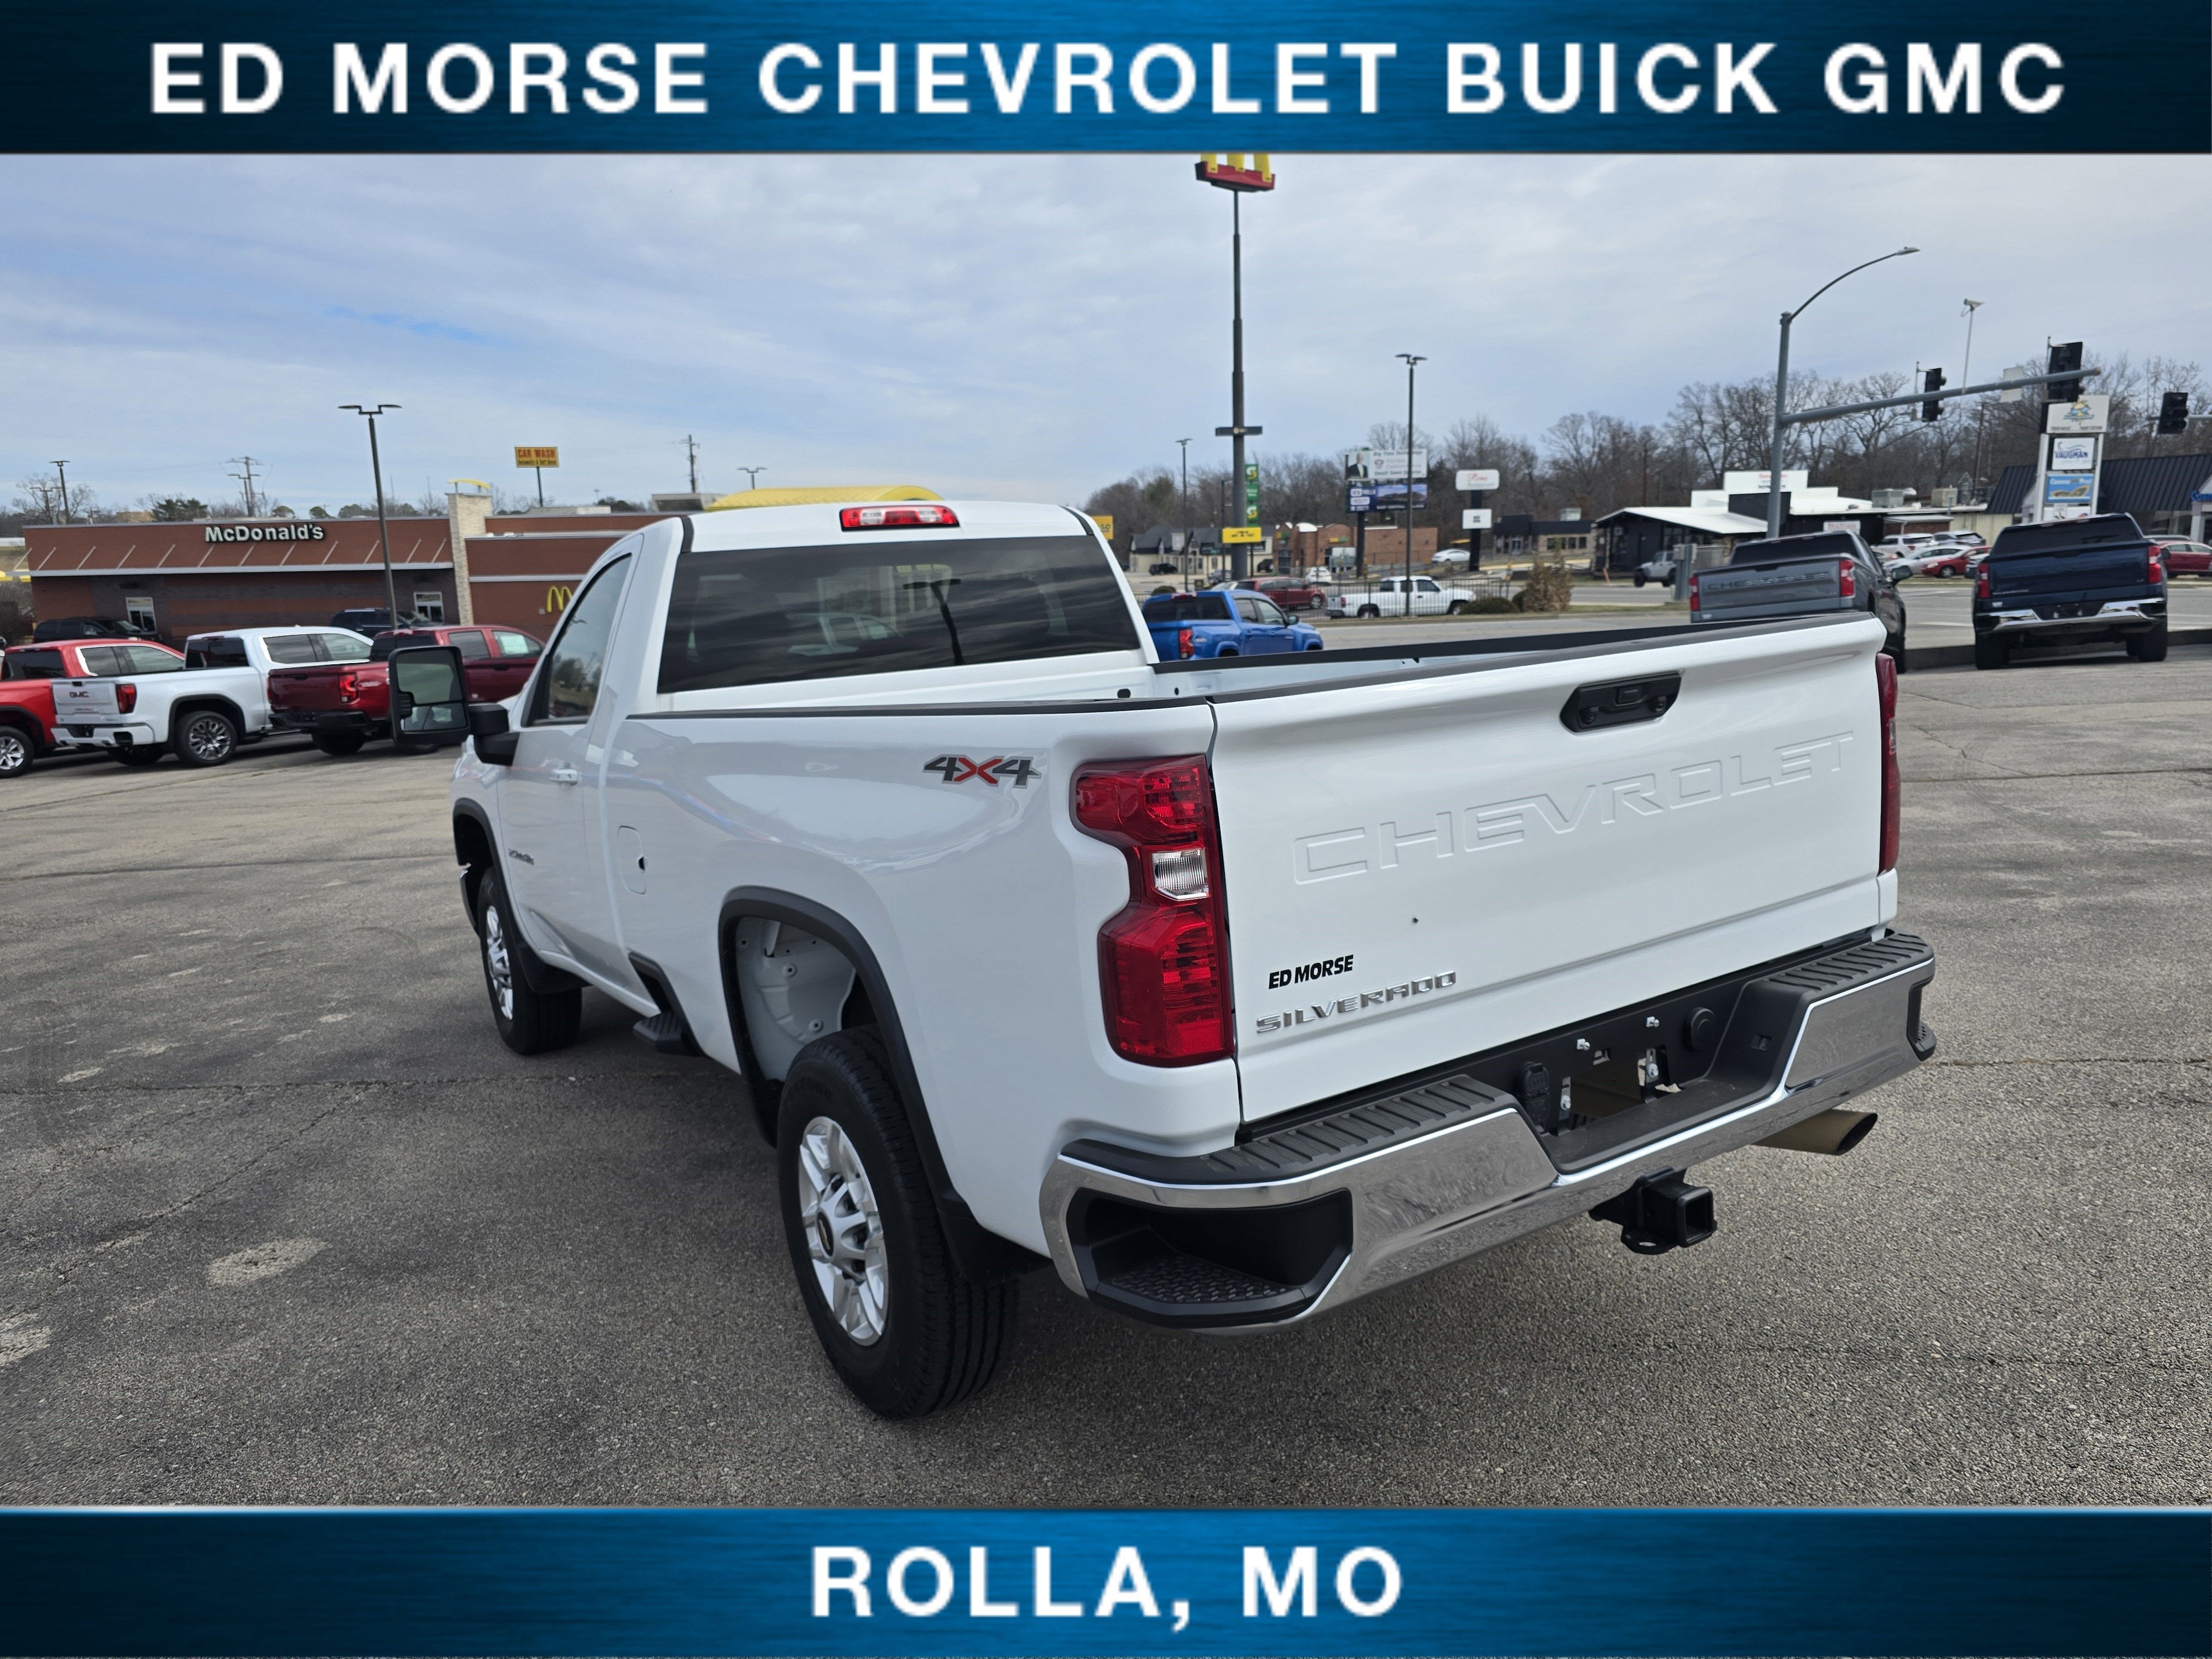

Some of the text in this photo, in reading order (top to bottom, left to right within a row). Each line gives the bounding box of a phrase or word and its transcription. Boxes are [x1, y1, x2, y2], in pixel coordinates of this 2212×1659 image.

[205, 524, 324, 542] McDonald's
[1293, 731, 1855, 885] CHEVROLET
[1269, 954, 1354, 989] ED MORSE
[1256, 971, 1457, 1034] SILVERADO
